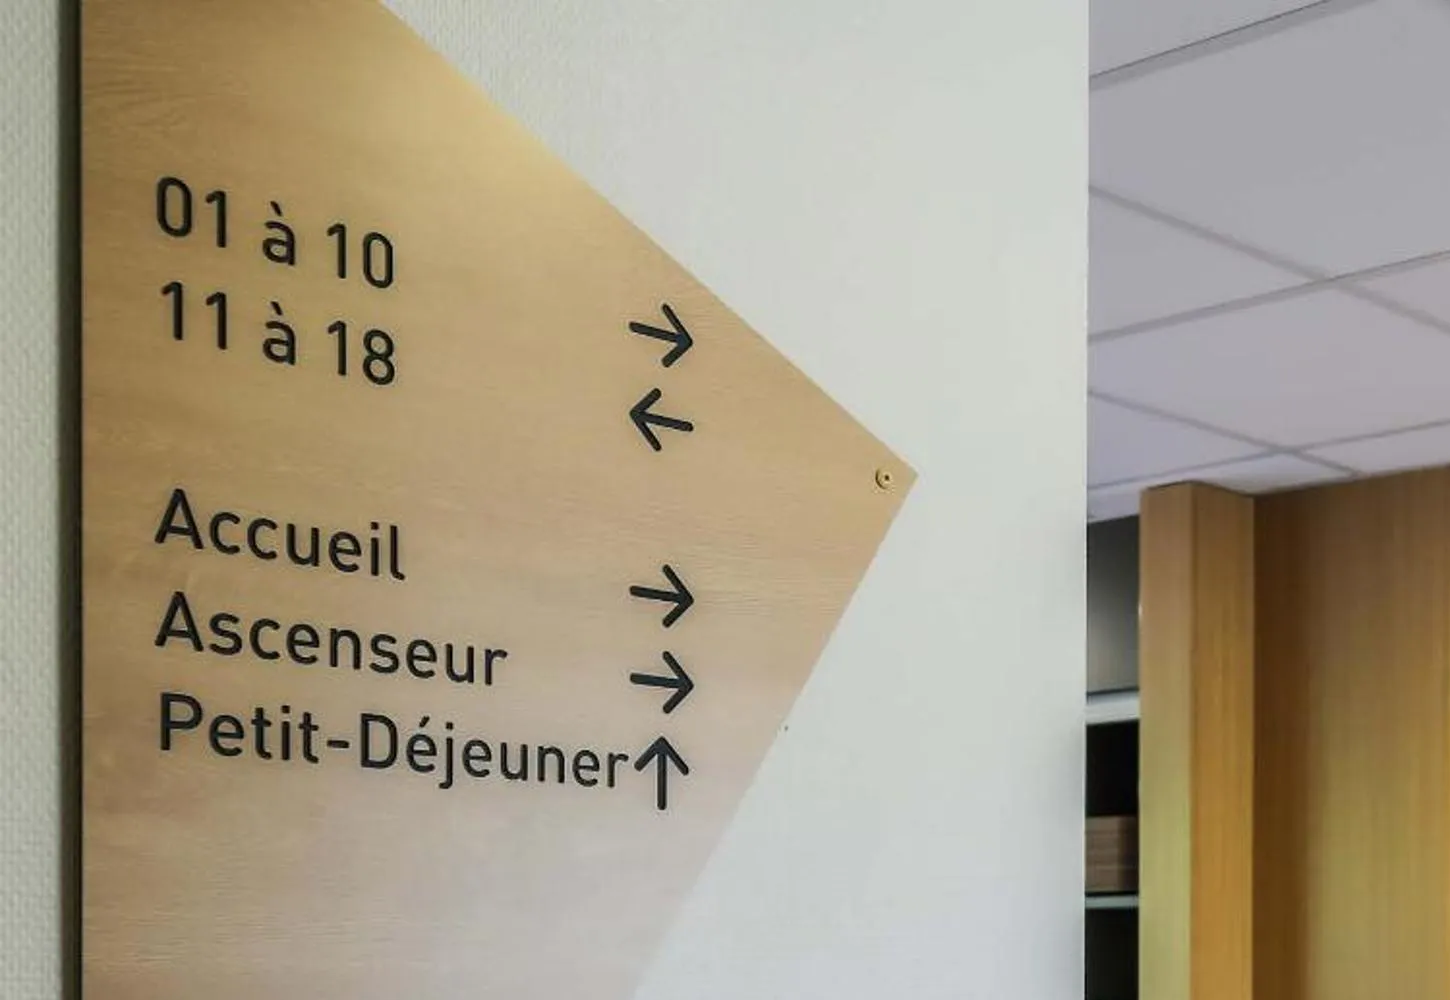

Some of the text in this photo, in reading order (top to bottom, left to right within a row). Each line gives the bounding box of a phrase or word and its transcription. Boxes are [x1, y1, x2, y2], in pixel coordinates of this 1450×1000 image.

[155, 175, 395, 290] 01 à 10
[160, 280, 396, 386] 11 à 18
[153, 487, 406, 582] Accueil
[153, 589, 509, 686] Ascenseur
[158, 690, 630, 790] Petit-Déjeuner
